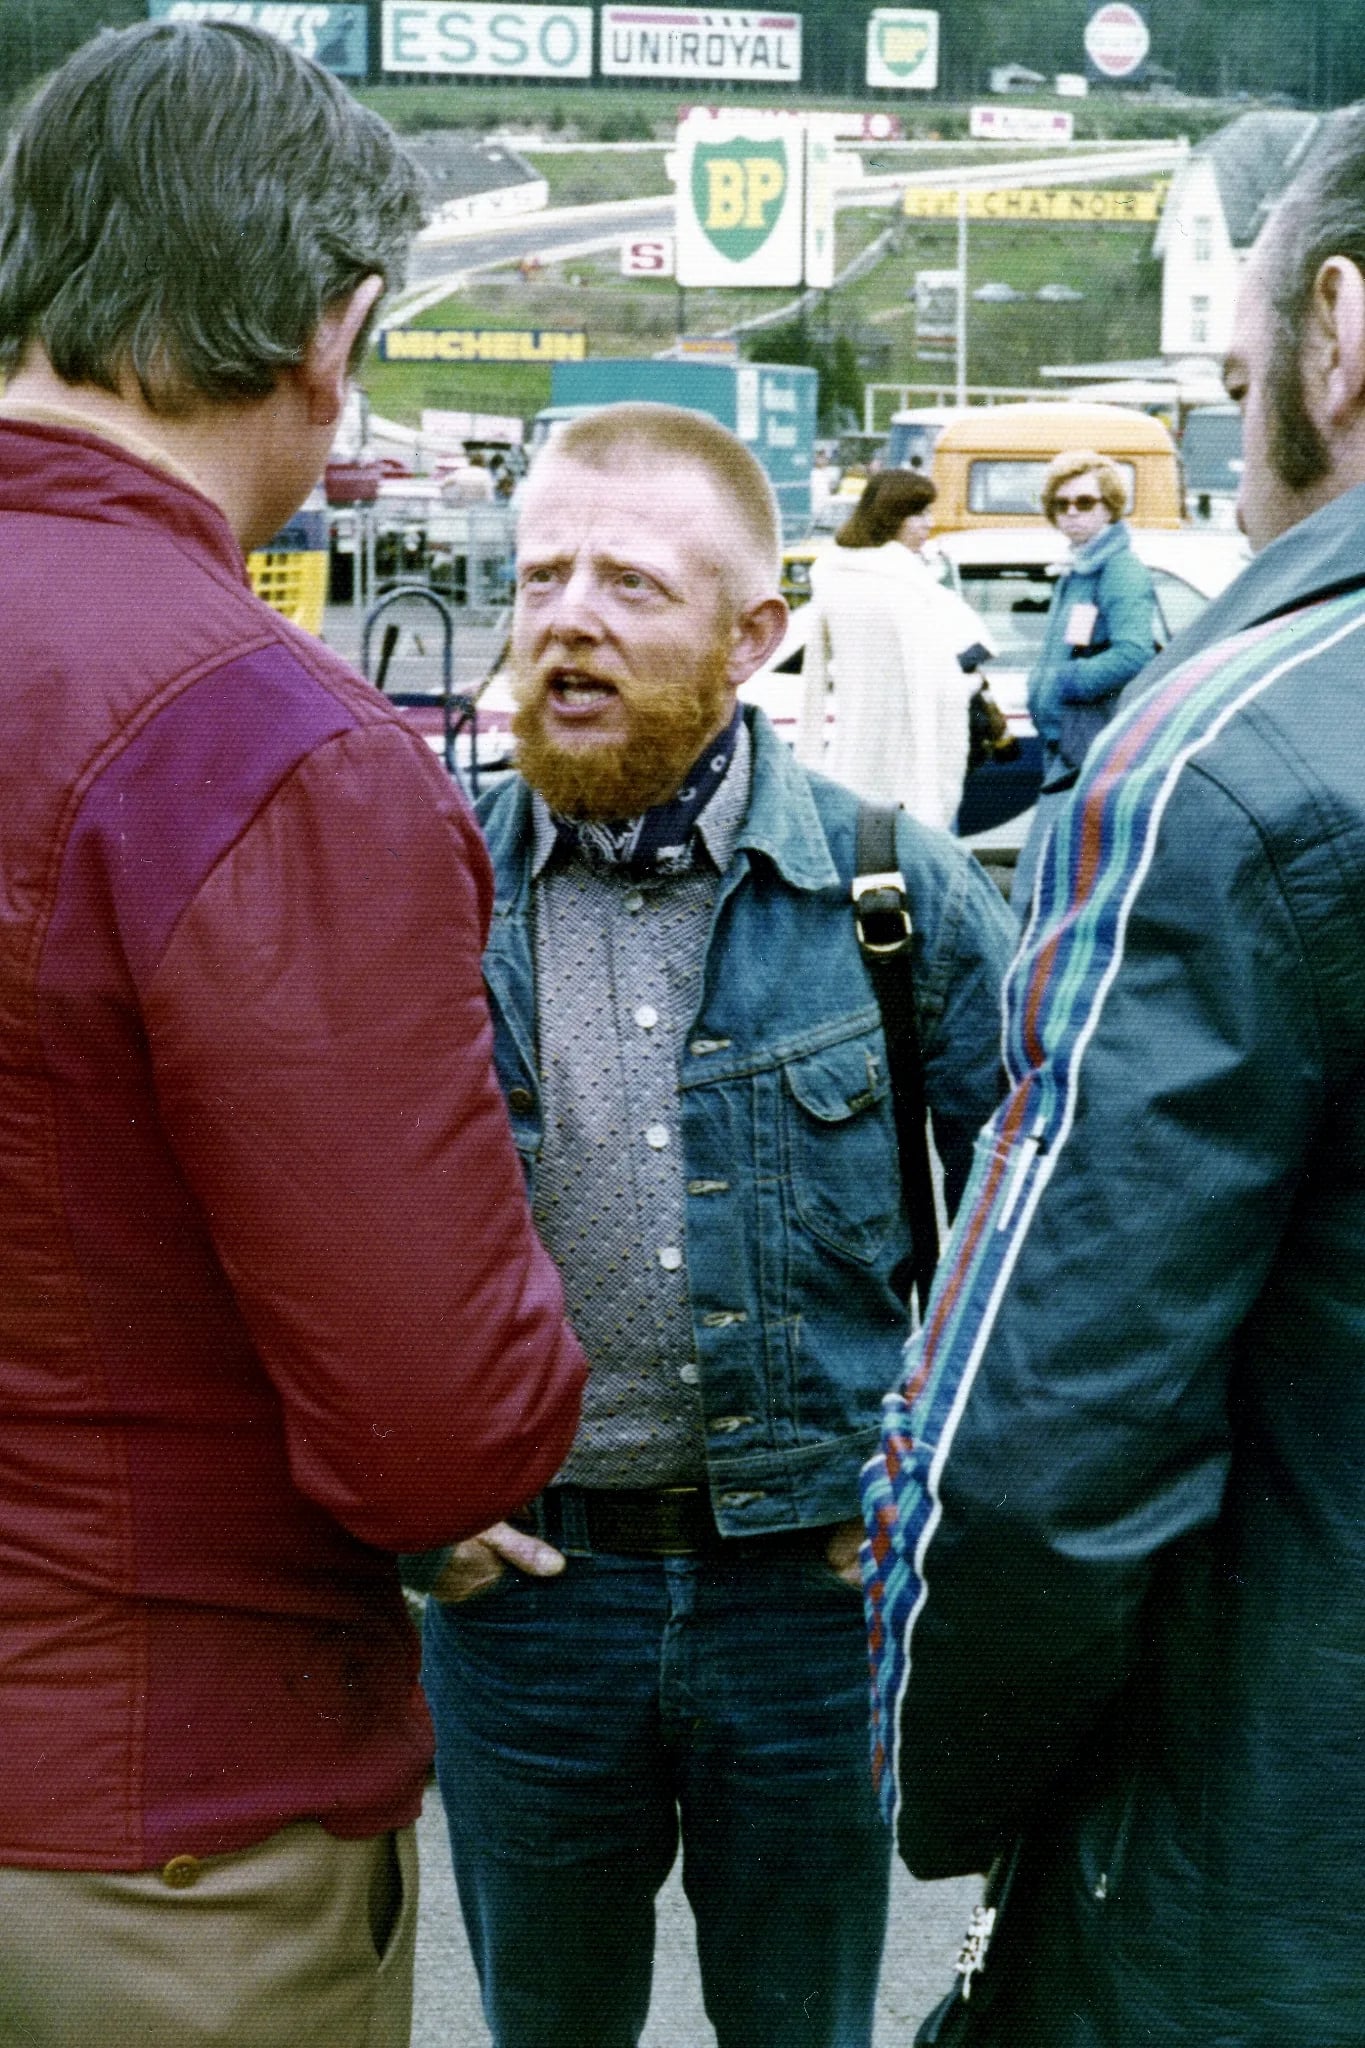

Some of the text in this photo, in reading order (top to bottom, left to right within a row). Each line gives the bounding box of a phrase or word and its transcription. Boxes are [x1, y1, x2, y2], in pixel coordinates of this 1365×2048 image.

[392, 9, 579, 67] ESSO
[613, 30, 790, 69] UNIROYAL
[706, 157, 785, 229] BP
